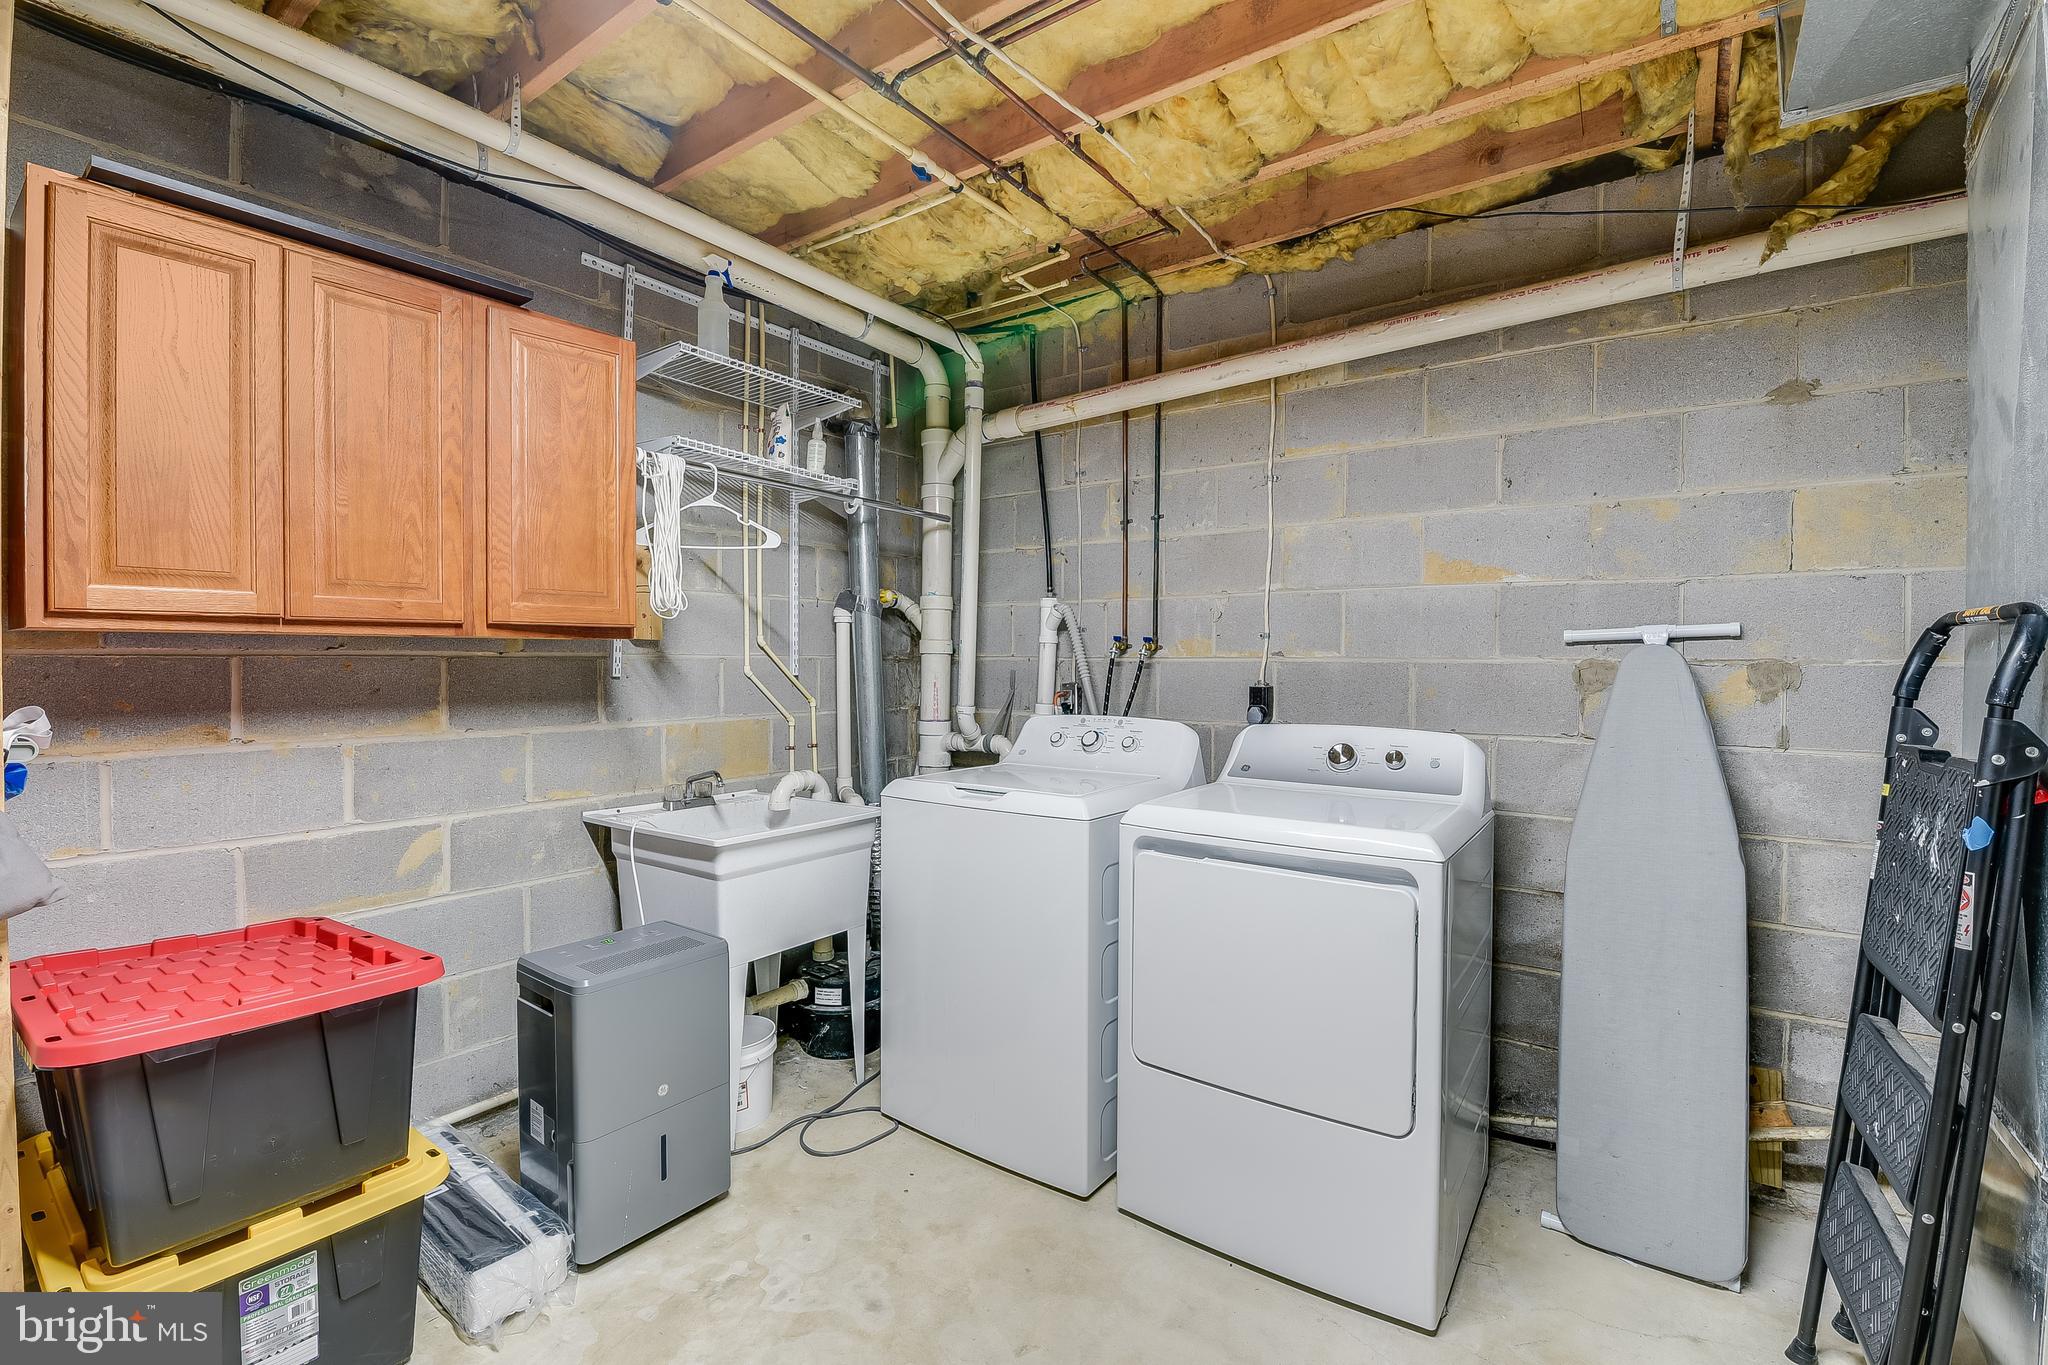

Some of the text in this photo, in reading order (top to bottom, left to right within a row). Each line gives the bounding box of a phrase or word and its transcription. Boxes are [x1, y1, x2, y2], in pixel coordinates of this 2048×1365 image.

[1653, 251, 1702, 266] CHAROTTE
[242, 1257, 312, 1291] Greenmade
[274, 1268, 311, 1288] STORAGE
[243, 1299, 285, 1322] PROFESSIONAL
[303, 1288, 316, 1297] BOX
[248, 1292, 261, 1304] NSF
